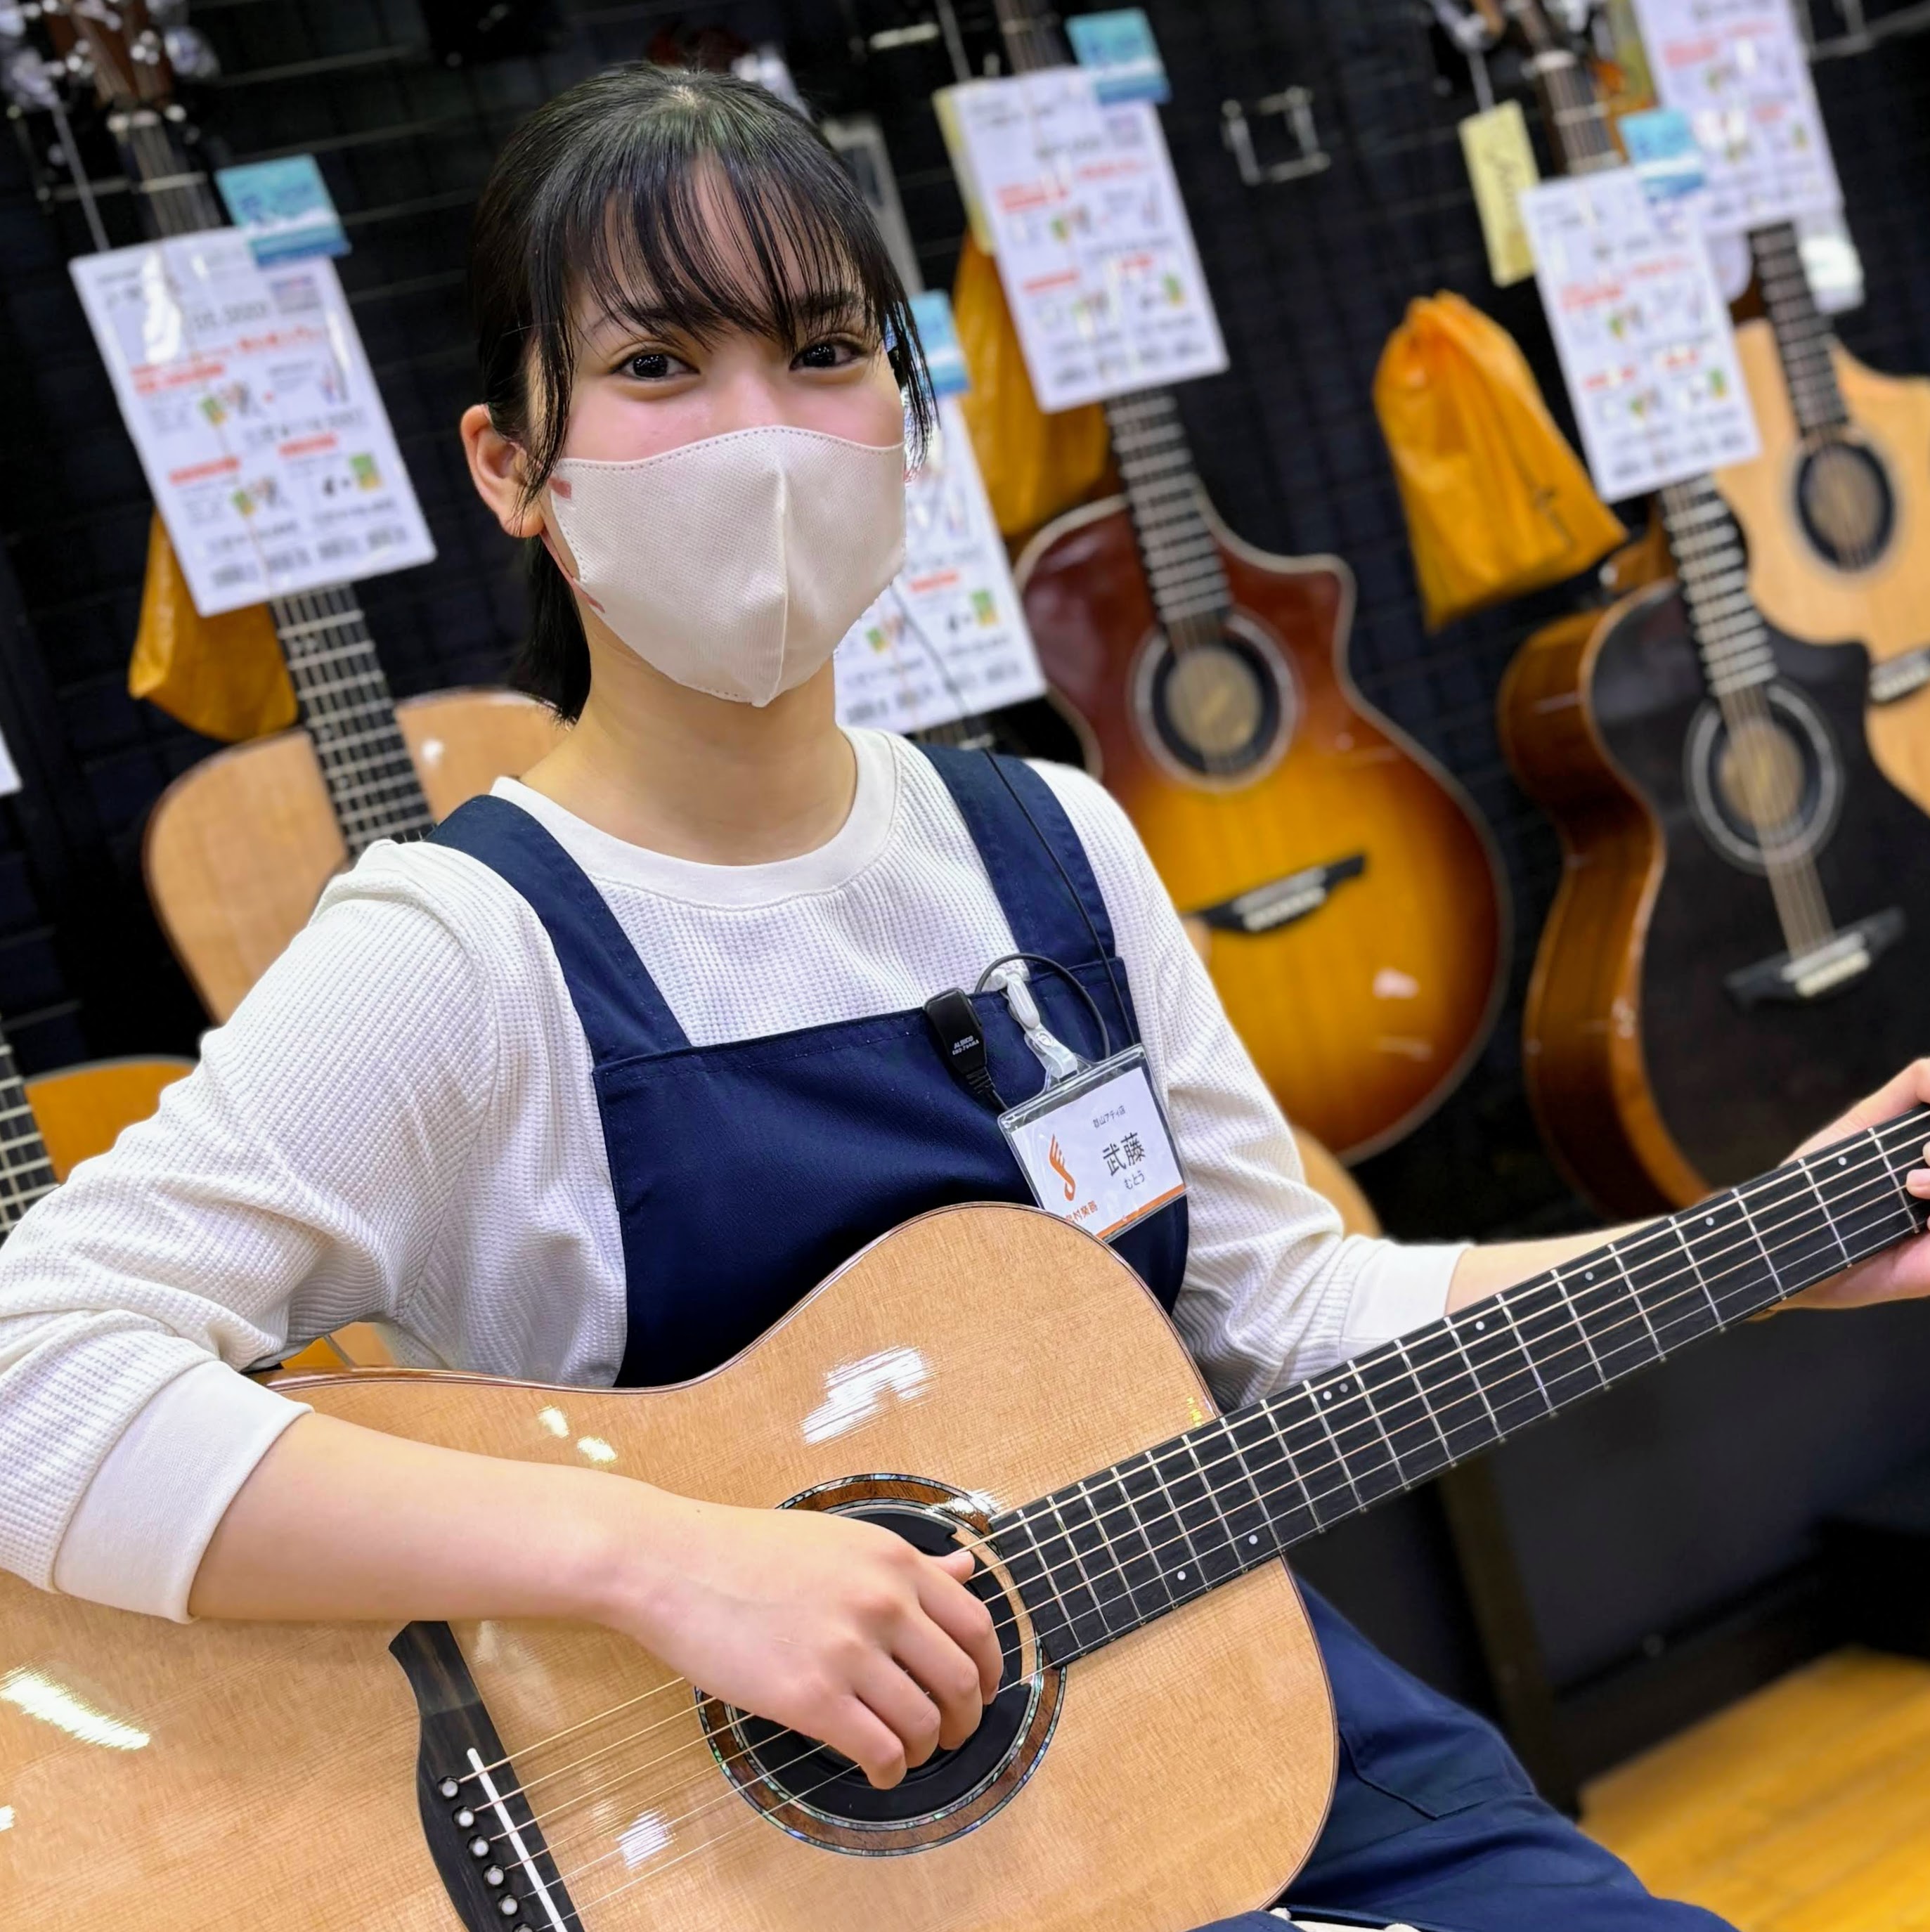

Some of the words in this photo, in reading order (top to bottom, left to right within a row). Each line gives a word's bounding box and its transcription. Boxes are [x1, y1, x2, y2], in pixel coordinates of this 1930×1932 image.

[1103, 1132, 1146, 1176] 武藤
[1125, 1170, 1145, 1189] むとう
